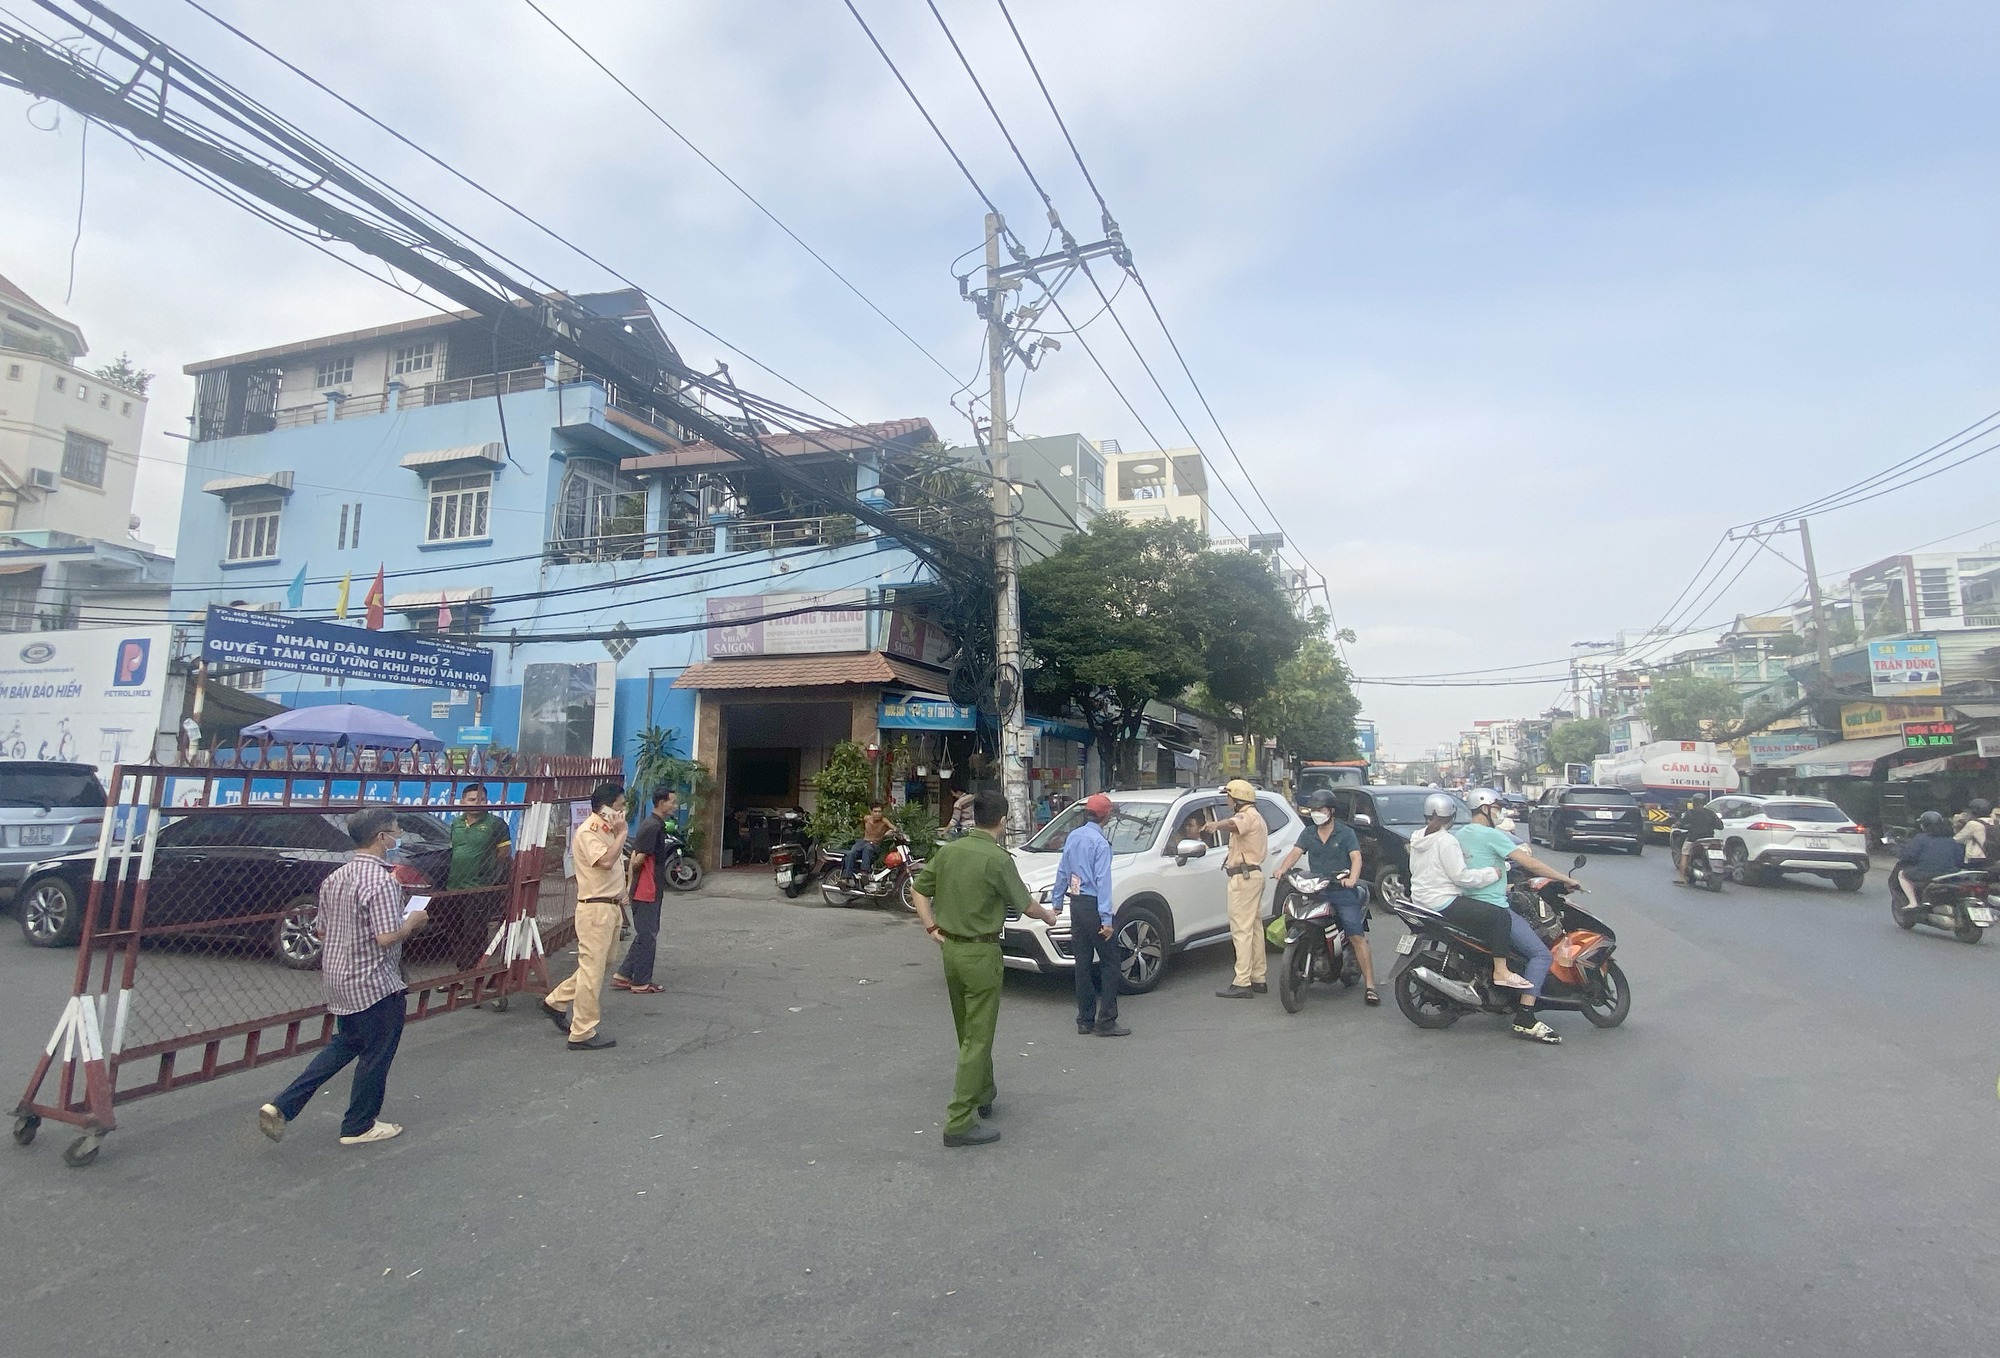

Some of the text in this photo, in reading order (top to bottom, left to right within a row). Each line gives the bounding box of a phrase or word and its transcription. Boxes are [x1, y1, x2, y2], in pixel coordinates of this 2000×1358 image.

[221, 615, 249, 624] UBND
[270, 616, 295, 625] MINH
[276, 634, 450, 667] NHÂN DÂN KHU PHỐ 2
[714, 642, 755, 654] SAIGON
[209, 639, 487, 683] QUYẾT TÂM GIỮ VỮNG KHU PHỐ VĂN HÓA
[225, 655, 261, 665] ĐƯỜNG
[263, 659, 298, 669] HUỲNH
[301, 663, 319, 672] TẤN
[321, 666, 346, 675] PHÁT
[32, 681, 54, 698] BẢO
[55, 679, 82, 698] HIỂM
[104, 690, 152, 698] PETROLIMEX
[1908, 735, 1953, 746] BÀ HAI
